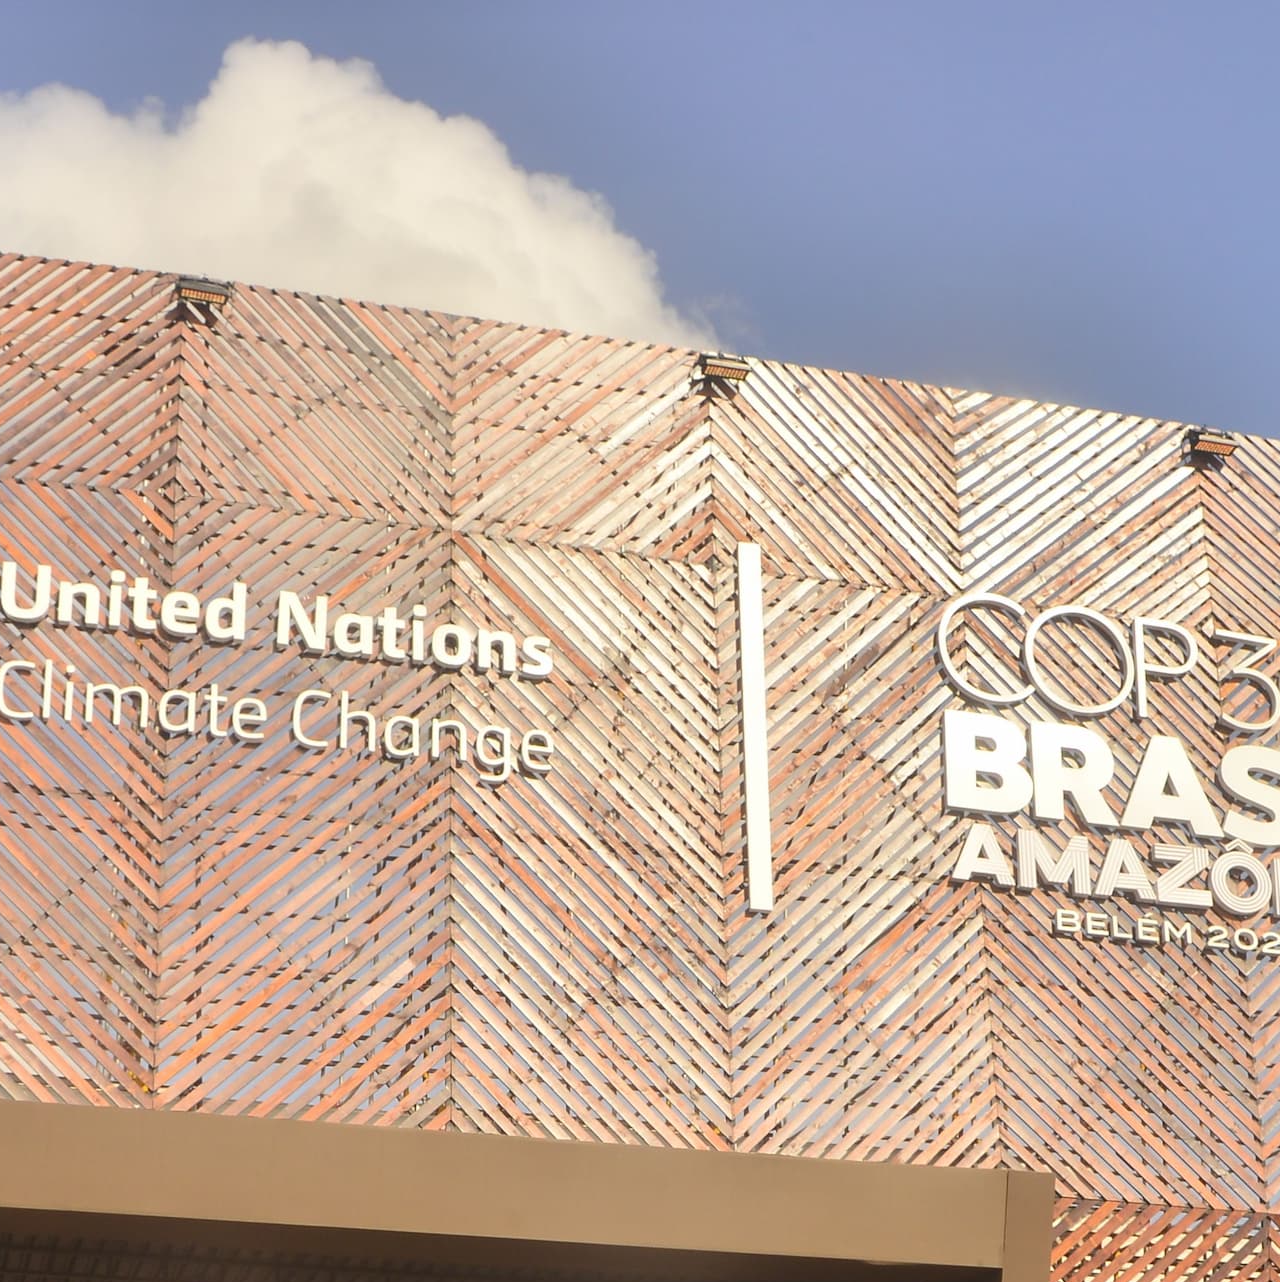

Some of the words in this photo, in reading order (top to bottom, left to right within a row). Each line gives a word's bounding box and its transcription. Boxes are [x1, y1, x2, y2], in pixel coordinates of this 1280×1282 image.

[276, 589, 555, 677] Nations
[291, 688, 555, 781] Change
[1054, 908, 1194, 945] BELÉM
